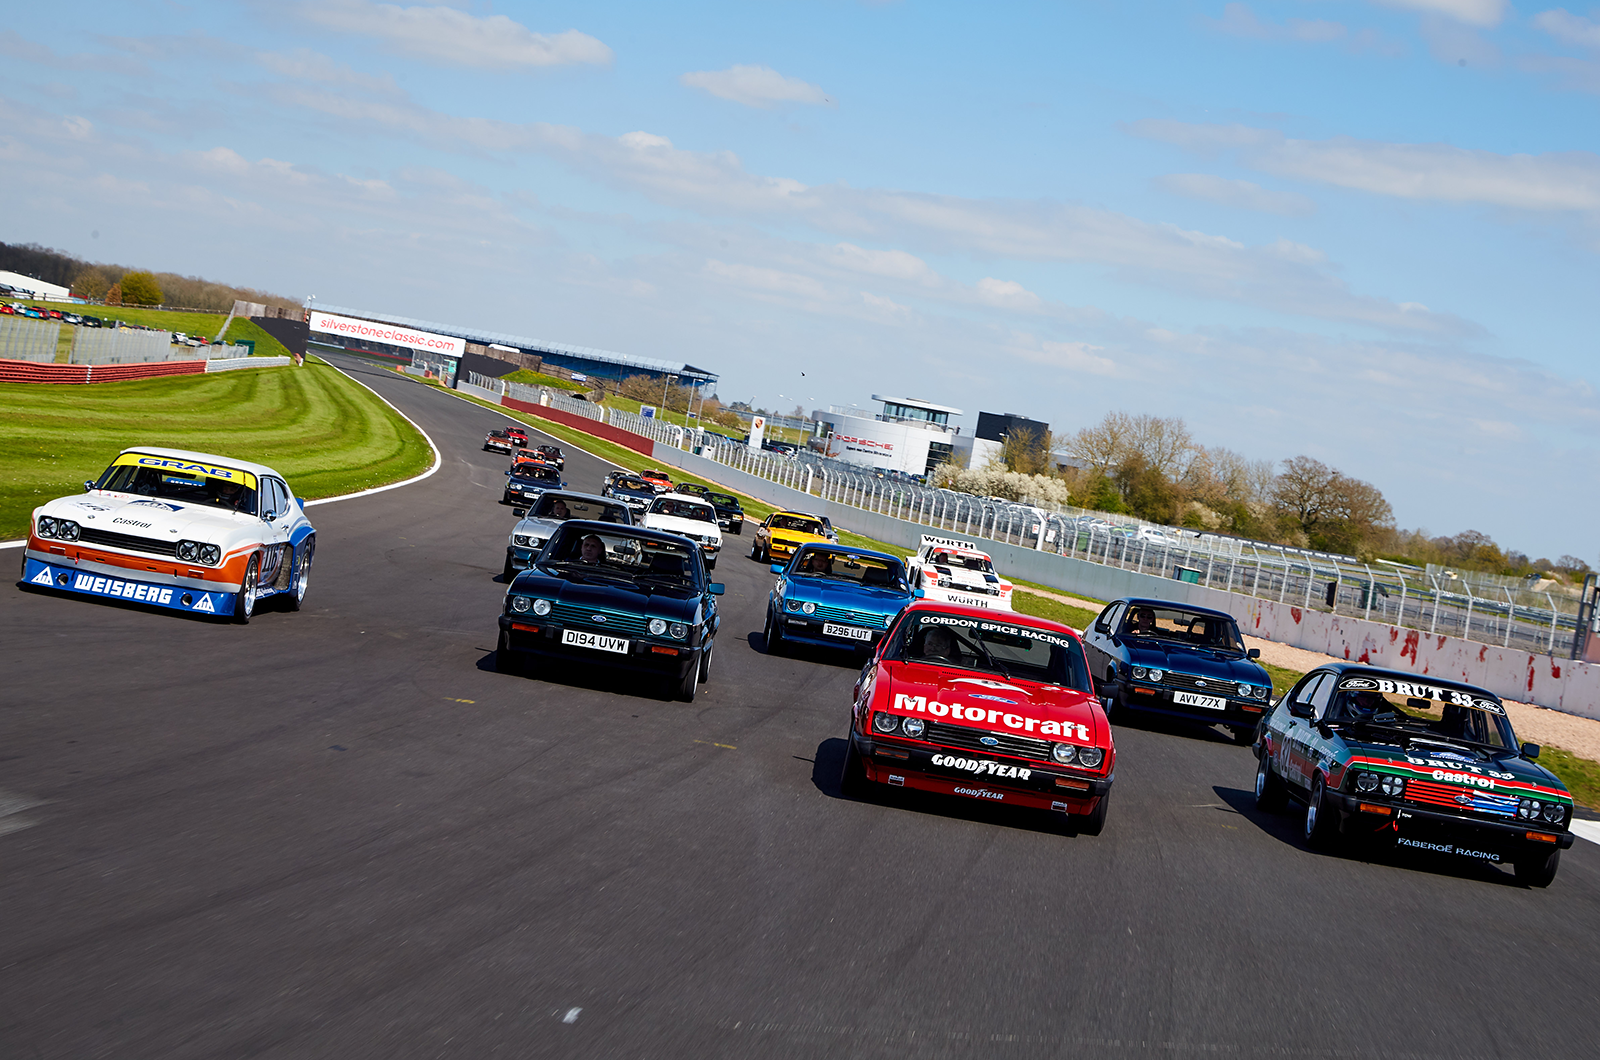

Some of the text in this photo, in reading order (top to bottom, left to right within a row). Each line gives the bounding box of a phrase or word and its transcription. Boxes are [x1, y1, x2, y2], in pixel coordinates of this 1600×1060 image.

[320, 318, 455, 351] silverstoneclassic.com
[138, 457, 233, 479] GRAB
[112, 517, 152, 529] Castrol
[74, 574, 173, 605] WEISBERG
[947, 594, 988, 608] WÜRTH
[566, 632, 626, 651] D194 UVW
[826, 625, 869, 640] B296 LUT
[920, 616, 1069, 649] GORDON SPICE RACING
[1179, 693, 1221, 708] AVV 77X
[1375, 679, 1474, 708] BRUT 33
[893, 693, 1090, 742] Motorcraft
[931, 753, 1032, 781] GOODYEAR
[1432, 770, 1495, 789] Castrol
[954, 786, 1004, 800] GOODYEAR
[1455, 848, 1500, 861] RACING
